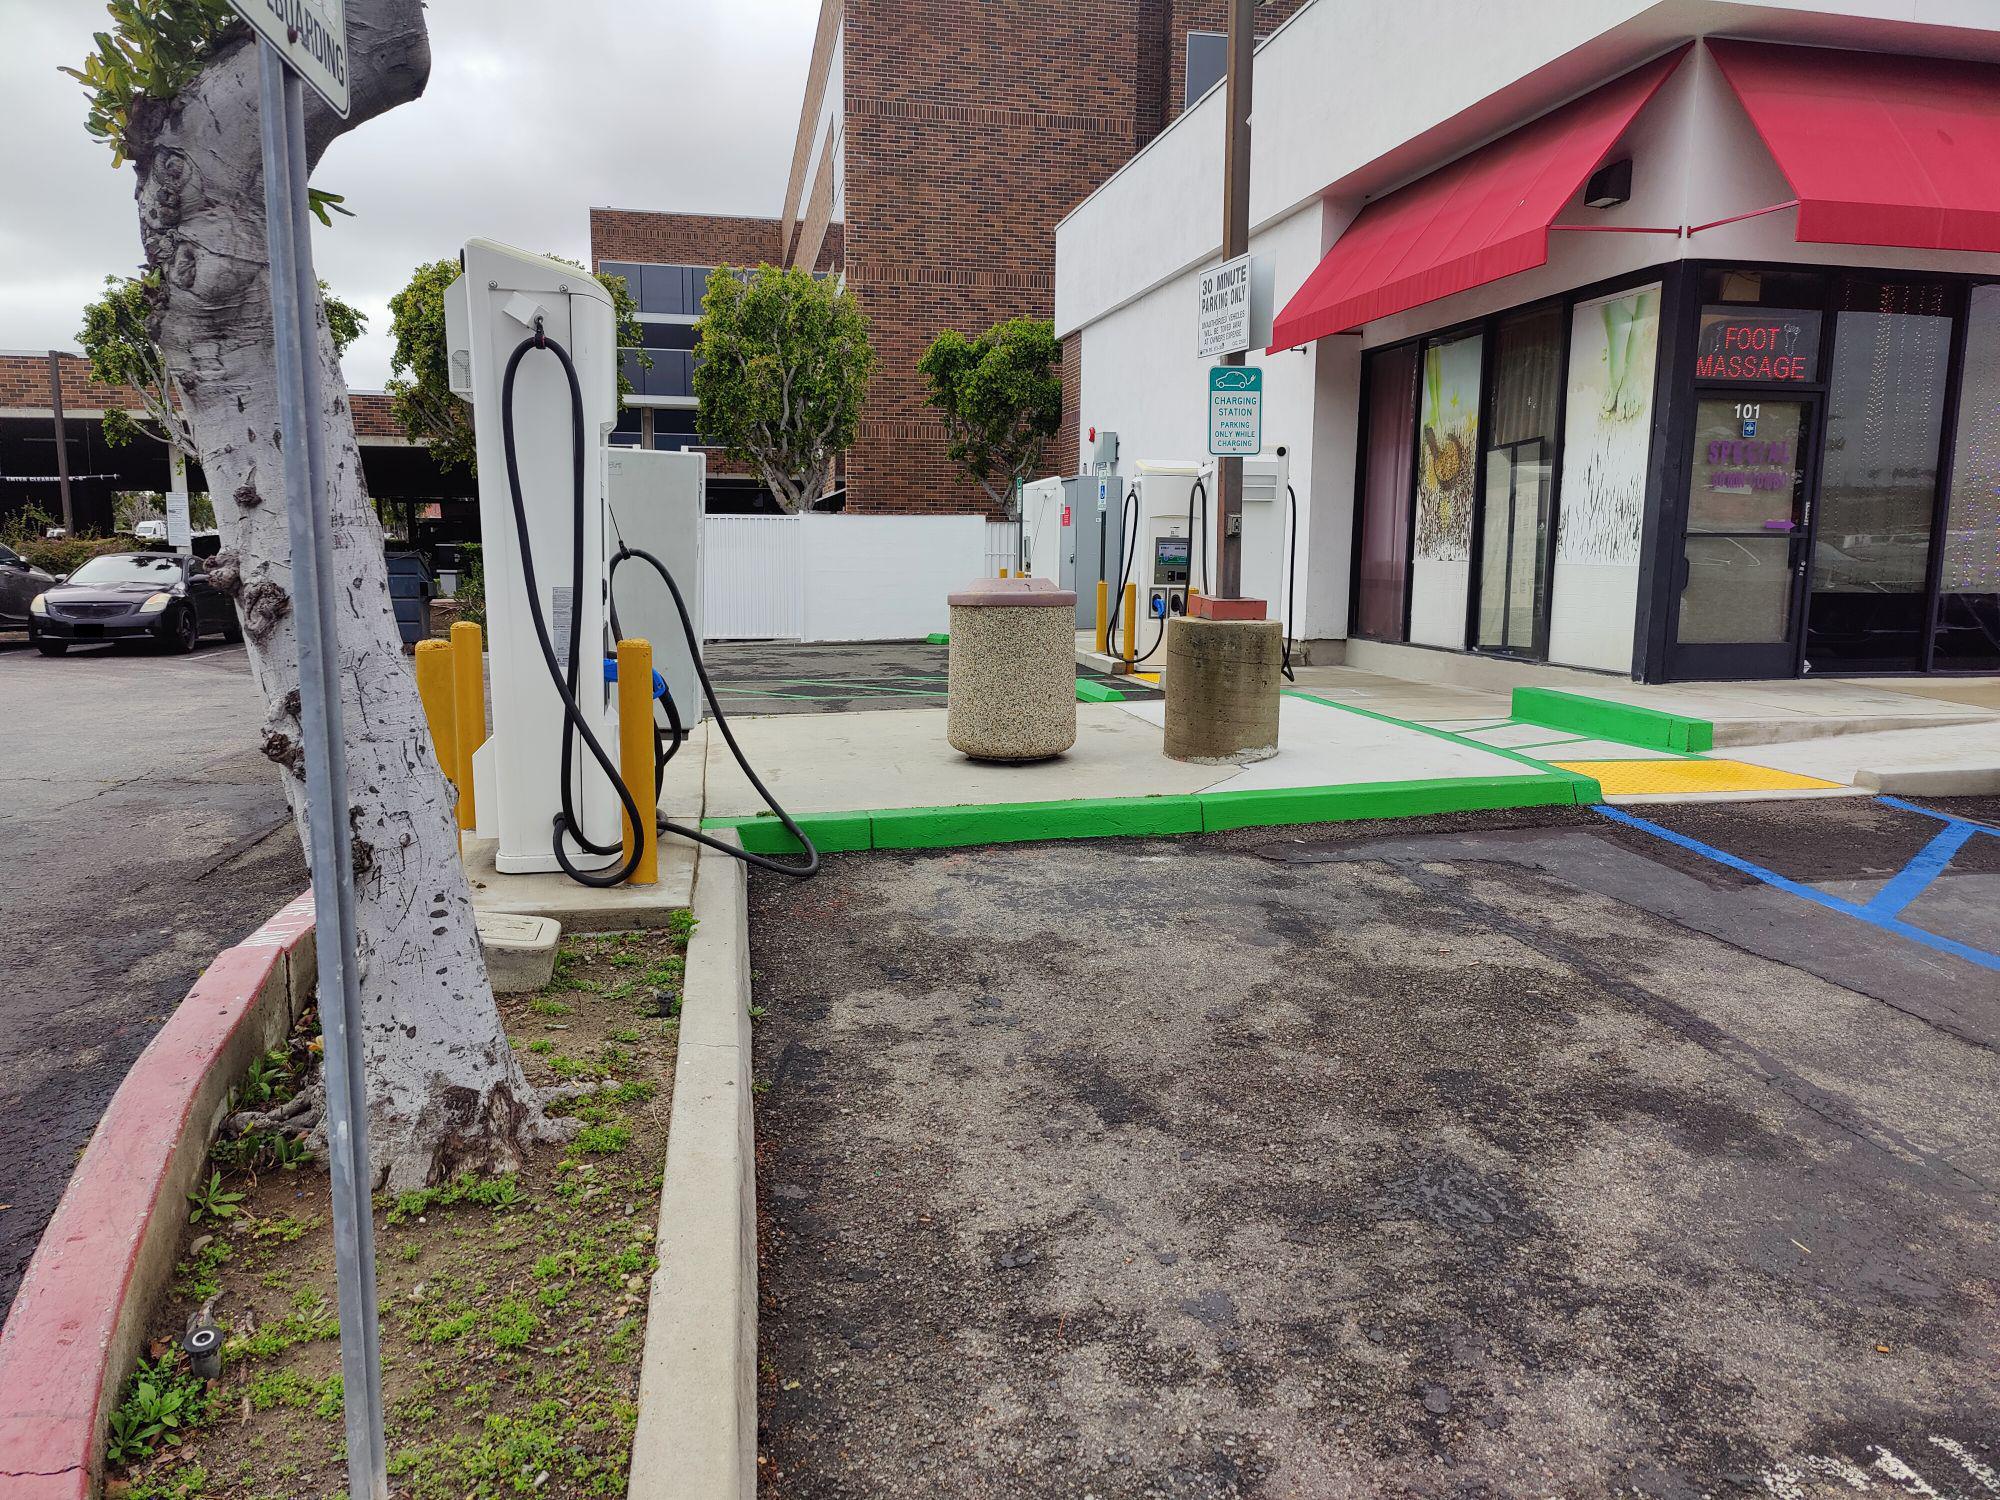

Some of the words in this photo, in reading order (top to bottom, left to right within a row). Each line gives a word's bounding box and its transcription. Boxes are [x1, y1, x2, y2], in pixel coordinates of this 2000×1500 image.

[267, 0, 345, 88] OARDING
[1202, 278, 1213, 296] 30
[1216, 264, 1247, 292] MINUTE
[1201, 291, 1228, 315] PARKING
[1230, 284, 1246, 305] ONLY
[1725, 327, 1780, 350] FOOT
[1696, 355, 1807, 378] MASSAGE
[1214, 397, 1257, 405] CHARGING
[1218, 408, 1252, 416] STATION
[1735, 403, 1760, 419] 101
[1220, 421, 1250, 429] PARKING
[1214, 430, 1233, 438] ONLY
[1235, 430, 1256, 438] WHILE
[1217, 439, 1252, 447] CHARGING
